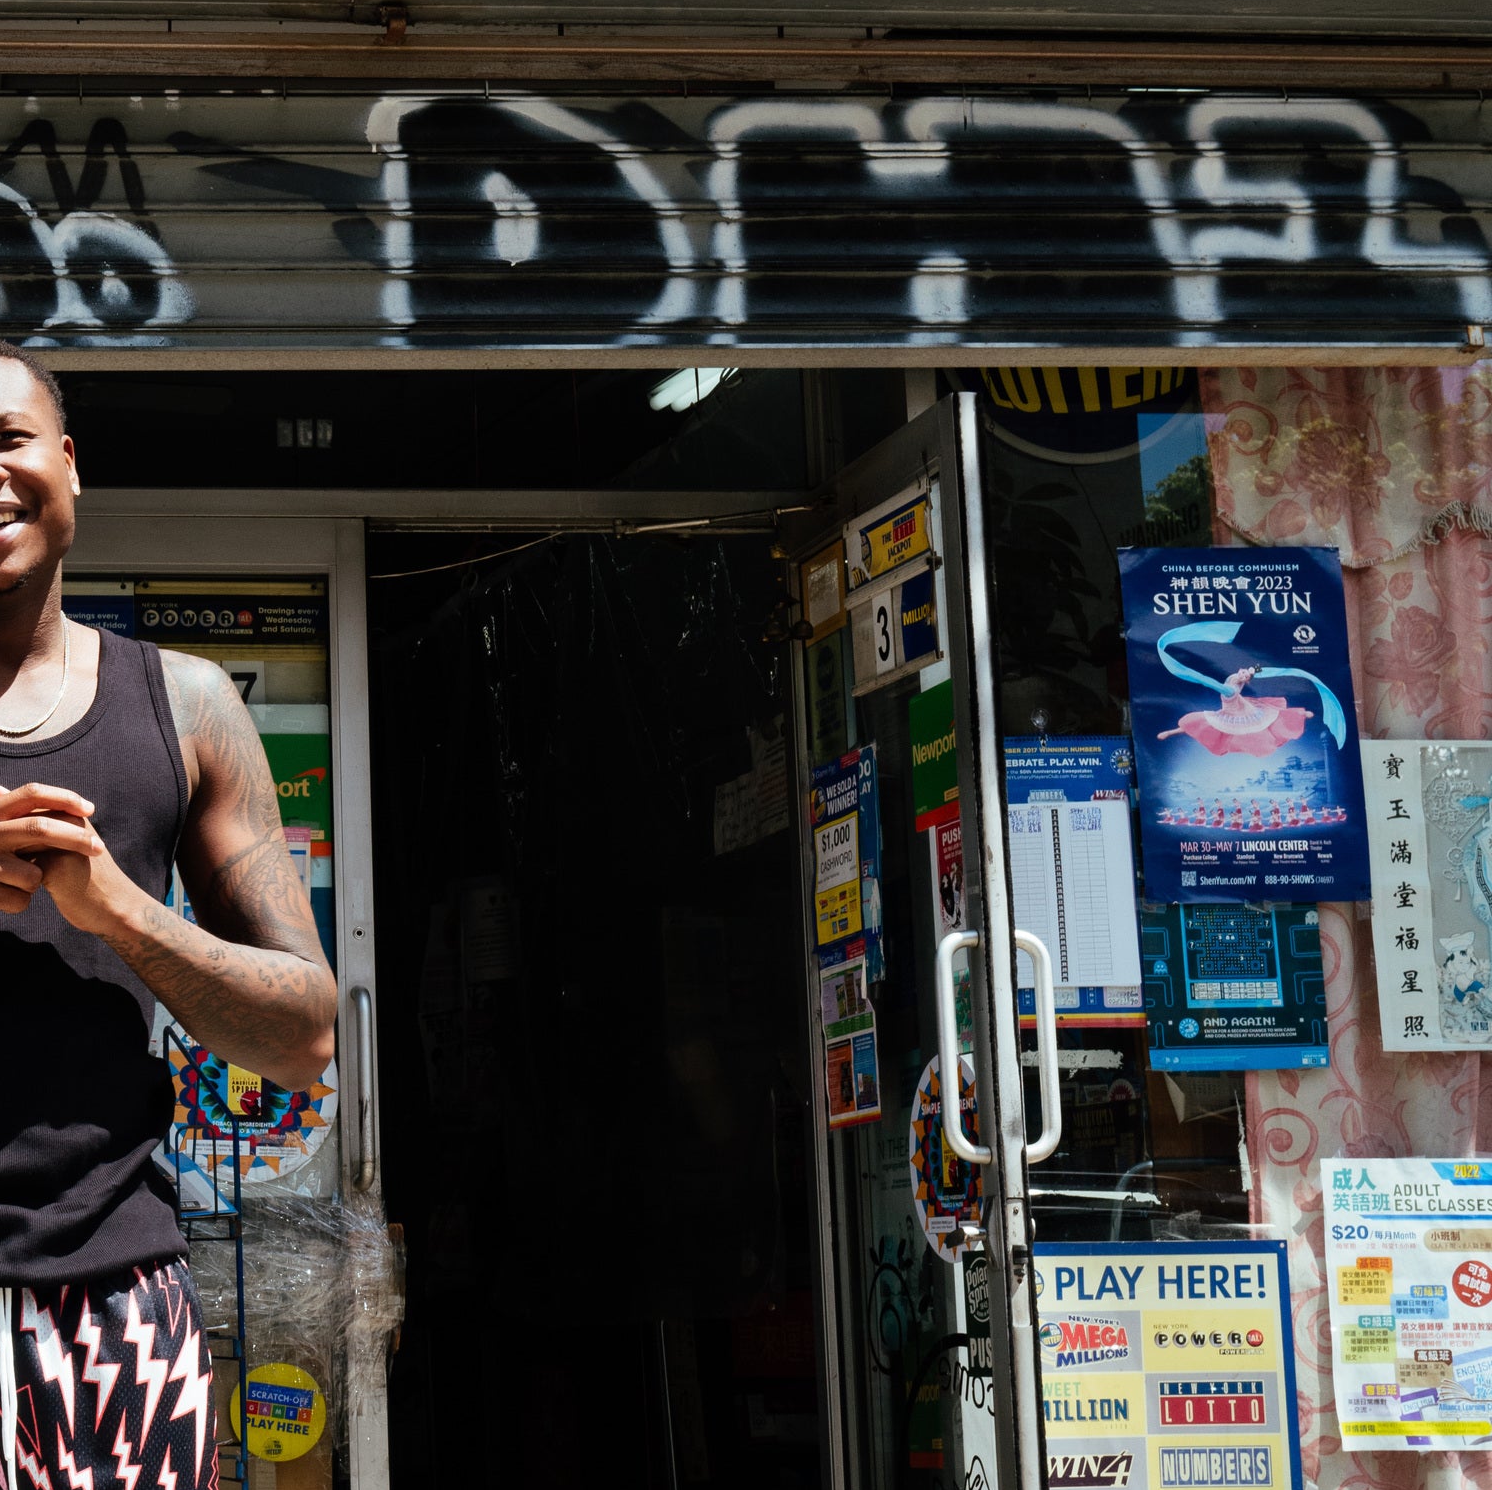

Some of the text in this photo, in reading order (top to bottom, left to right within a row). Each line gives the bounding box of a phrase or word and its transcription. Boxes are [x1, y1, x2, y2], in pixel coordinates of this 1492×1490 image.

[888, 538, 911, 561] JACKPOT
[1238, 563, 1300, 572] COMMUNISM
[1170, 576, 1293, 590] 神韻晚會 2023
[1153, 592, 1311, 615] SHEN YUN
[258, 607, 295, 616] Drawings
[265, 616, 312, 625] Wednesday
[280, 626, 316, 634] Saturday
[876, 606, 890, 662] 3
[1006, 758, 1048, 767] EBRATE.
[837, 777, 852, 795] SOLD
[827, 789, 857, 816] WINNER!
[822, 823, 850, 853] $1,000
[1241, 840, 1277, 852] LINCOLN
[1278, 840, 1308, 851] CENTER
[820, 850, 853, 875] CASHWORD
[1200, 875, 1257, 886] ShenYun.com/NY
[1265, 875, 1315, 884] 888-90-SHOWS
[1382, 752, 1429, 1038] 寶玉滿堂福星照
[1231, 1017, 1276, 1026] AGAIN!
[1454, 1164, 1480, 1178] 2022
[1332, 1168, 1376, 1191] 成人
[1394, 1184, 1441, 1197] ADULT
[1333, 1193, 1390, 1212] 英語班
[1395, 1199, 1423, 1212] ESL
[1332, 1225, 1369, 1241] $20
[1055, 1264, 1266, 1301] PLAY HERE!
[1361, 1316, 1393, 1327] 中級班
[1059, 1322, 1128, 1351] MEGA
[970, 1338, 993, 1368] PUS
[1056, 1347, 1128, 1368] MILLIONS
[1161, 1382, 1257, 1394] NEW YORK
[252, 1390, 309, 1405] SCRATCH-OFF
[249, 1405, 308, 1418] GAMES
[1164, 1400, 1259, 1422] LOTTO
[277, 1421, 310, 1435] HERE
[1162, 1448, 1268, 1483] NUMBERS
